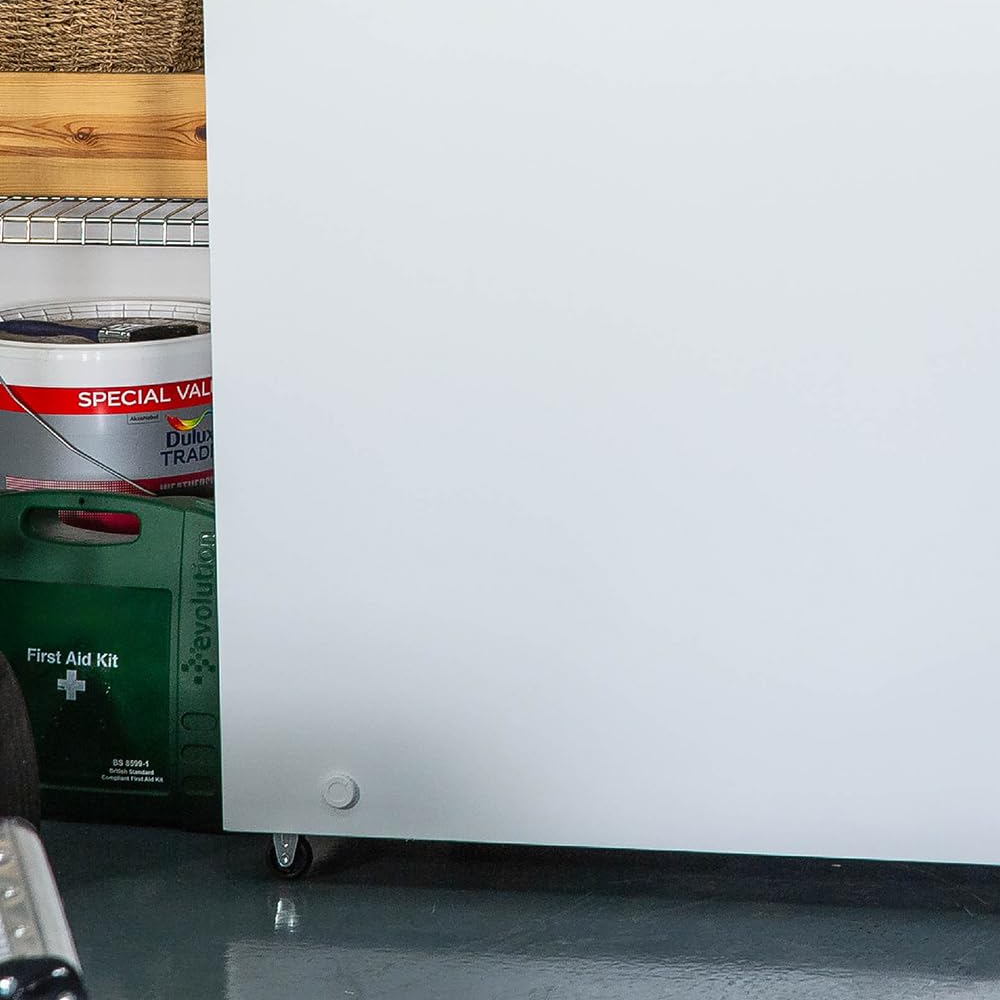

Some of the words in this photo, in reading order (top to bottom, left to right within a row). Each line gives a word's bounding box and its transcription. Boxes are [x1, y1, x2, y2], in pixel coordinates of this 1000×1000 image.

[78, 387, 171, 408] SPECIAL
[176, 382, 212, 400] VAL
[160, 446, 214, 467] TRAD
[191, 532, 216, 650] evolution
[27, 647, 62, 665] First
[65, 650, 92, 667] Aid
[96, 652, 119, 668] Kit
